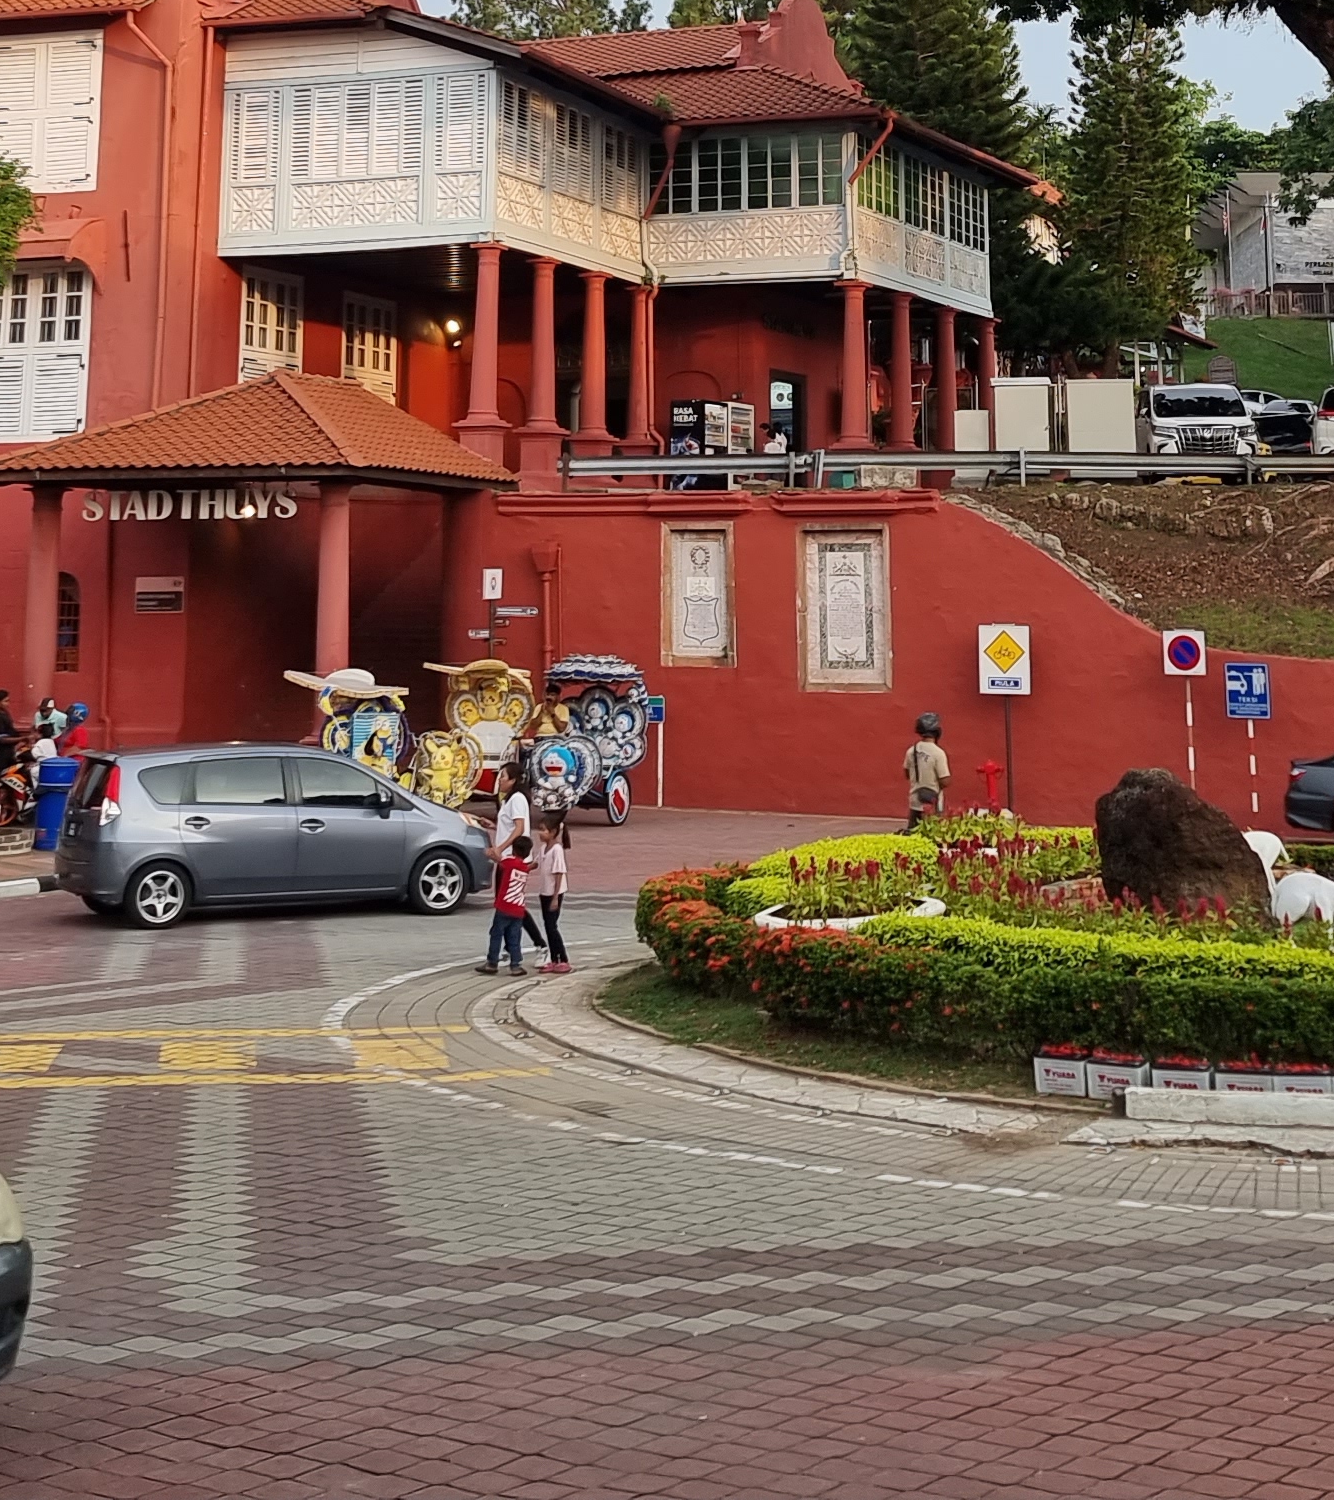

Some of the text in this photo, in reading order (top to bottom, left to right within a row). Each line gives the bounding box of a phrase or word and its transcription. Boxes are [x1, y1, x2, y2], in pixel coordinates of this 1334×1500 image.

[82, 489, 298, 522] STADTHUYS
[1052, 1071, 1076, 1080] YUASA
[1106, 1077, 1131, 1086] YUASA
